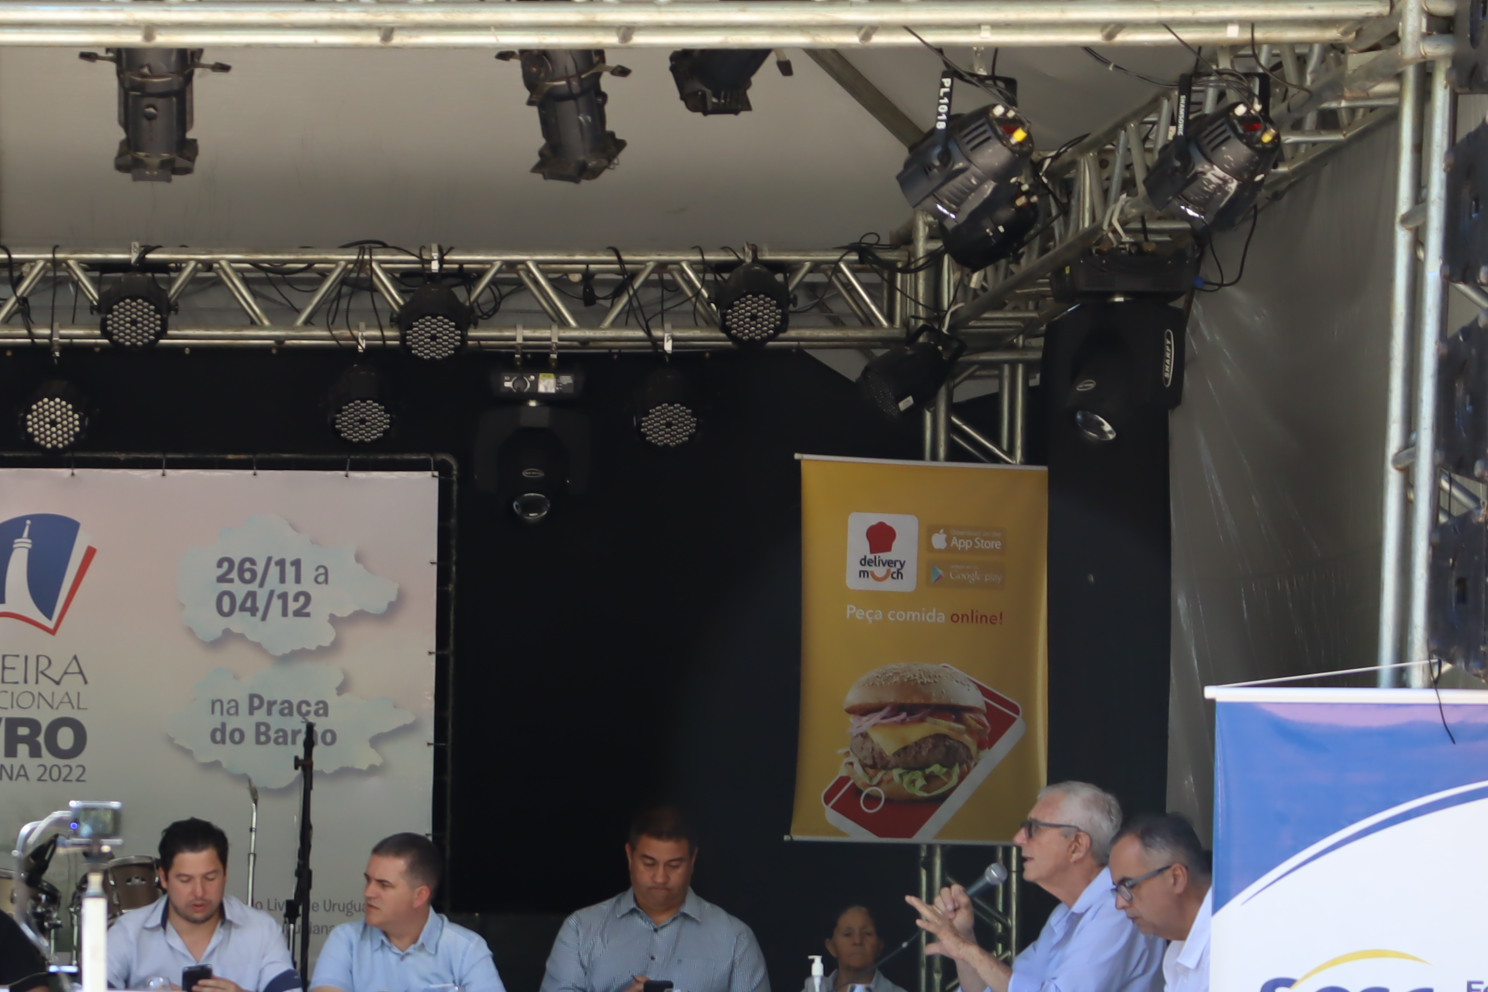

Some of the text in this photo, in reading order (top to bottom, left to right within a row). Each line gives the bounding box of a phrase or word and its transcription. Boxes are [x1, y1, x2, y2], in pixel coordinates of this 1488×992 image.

[936, 78, 952, 130] PL1018
[950, 536, 1002, 551] App Store
[216, 556, 329, 588] 26/11 a
[859, 555, 906, 570] delivery
[216, 590, 312, 621] 04/12
[846, 604, 1004, 625] Peça comida online!
[211, 693, 329, 721] na Praça
[210, 722, 337, 746] do Baro
[36, 764, 87, 782] 2022
